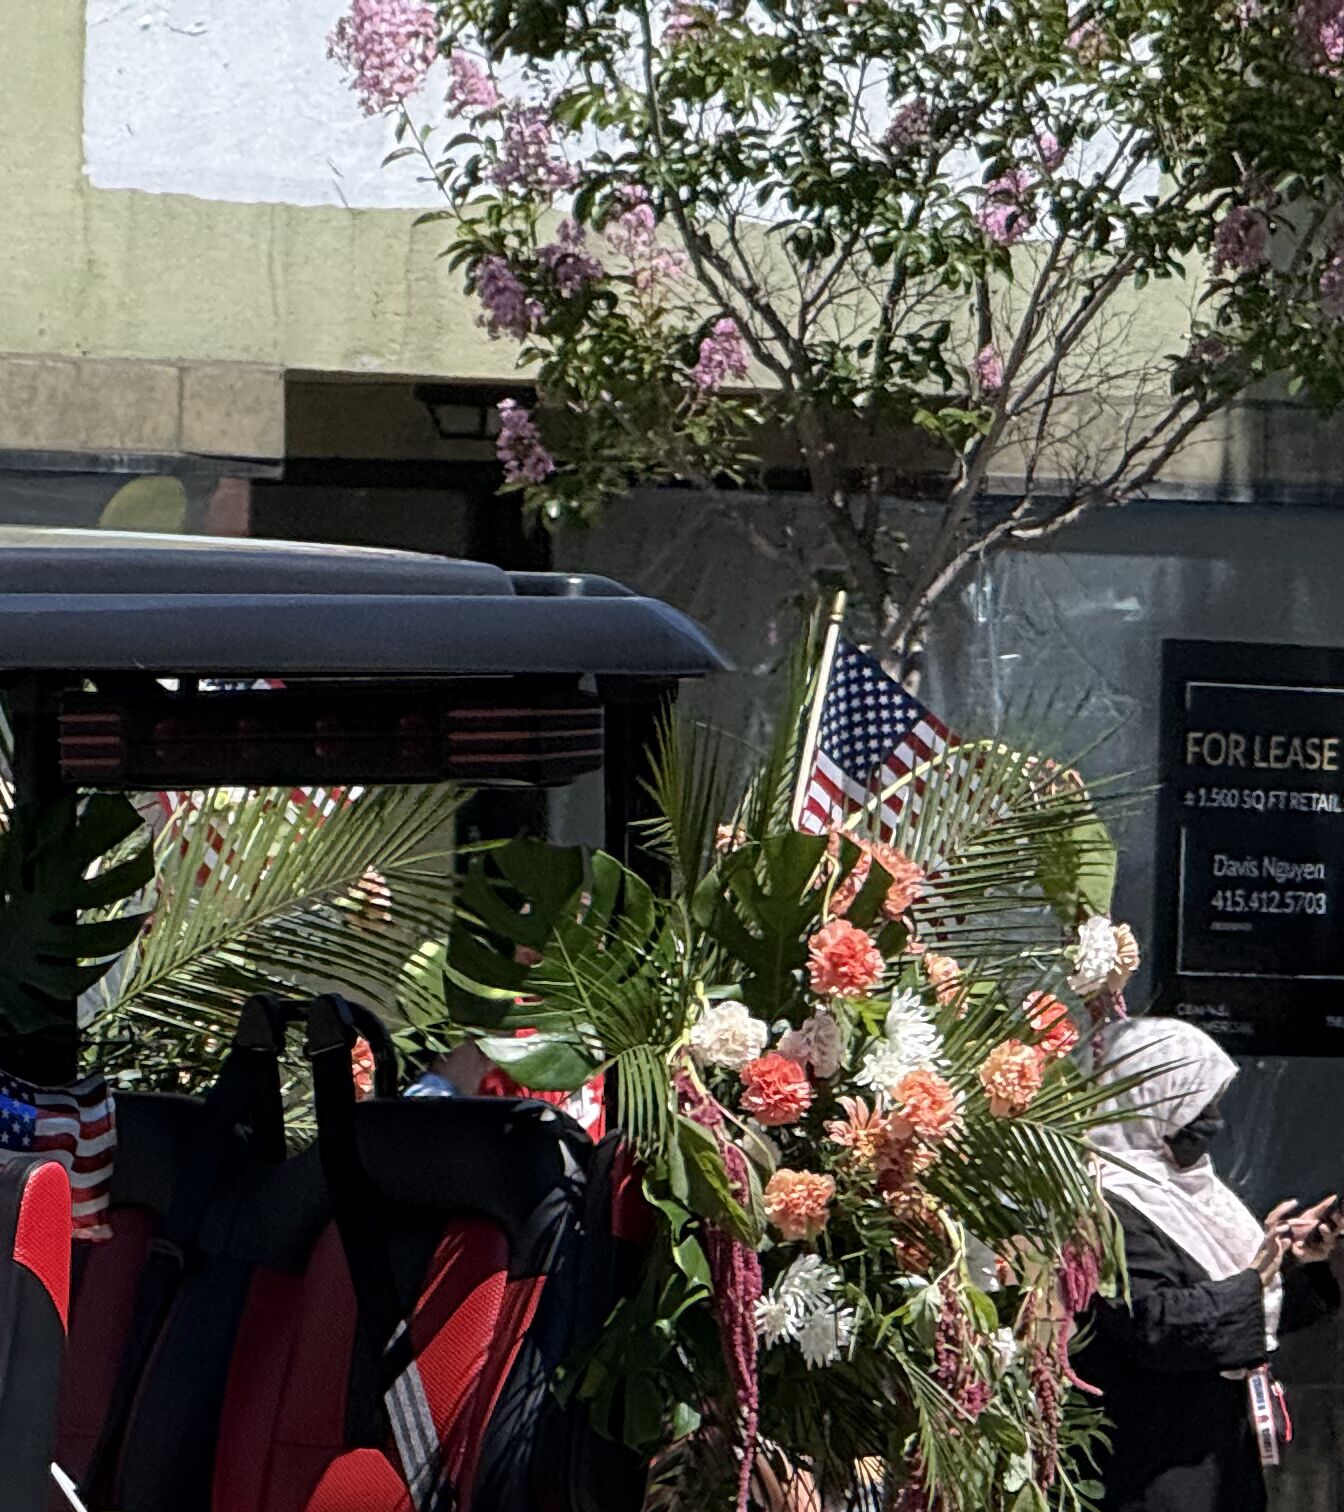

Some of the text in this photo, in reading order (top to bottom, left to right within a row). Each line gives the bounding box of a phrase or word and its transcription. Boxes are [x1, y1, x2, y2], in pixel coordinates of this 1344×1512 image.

[1185, 731, 1340, 772] FOR LEASE
[1212, 853, 1326, 884] Davis Nguyen
